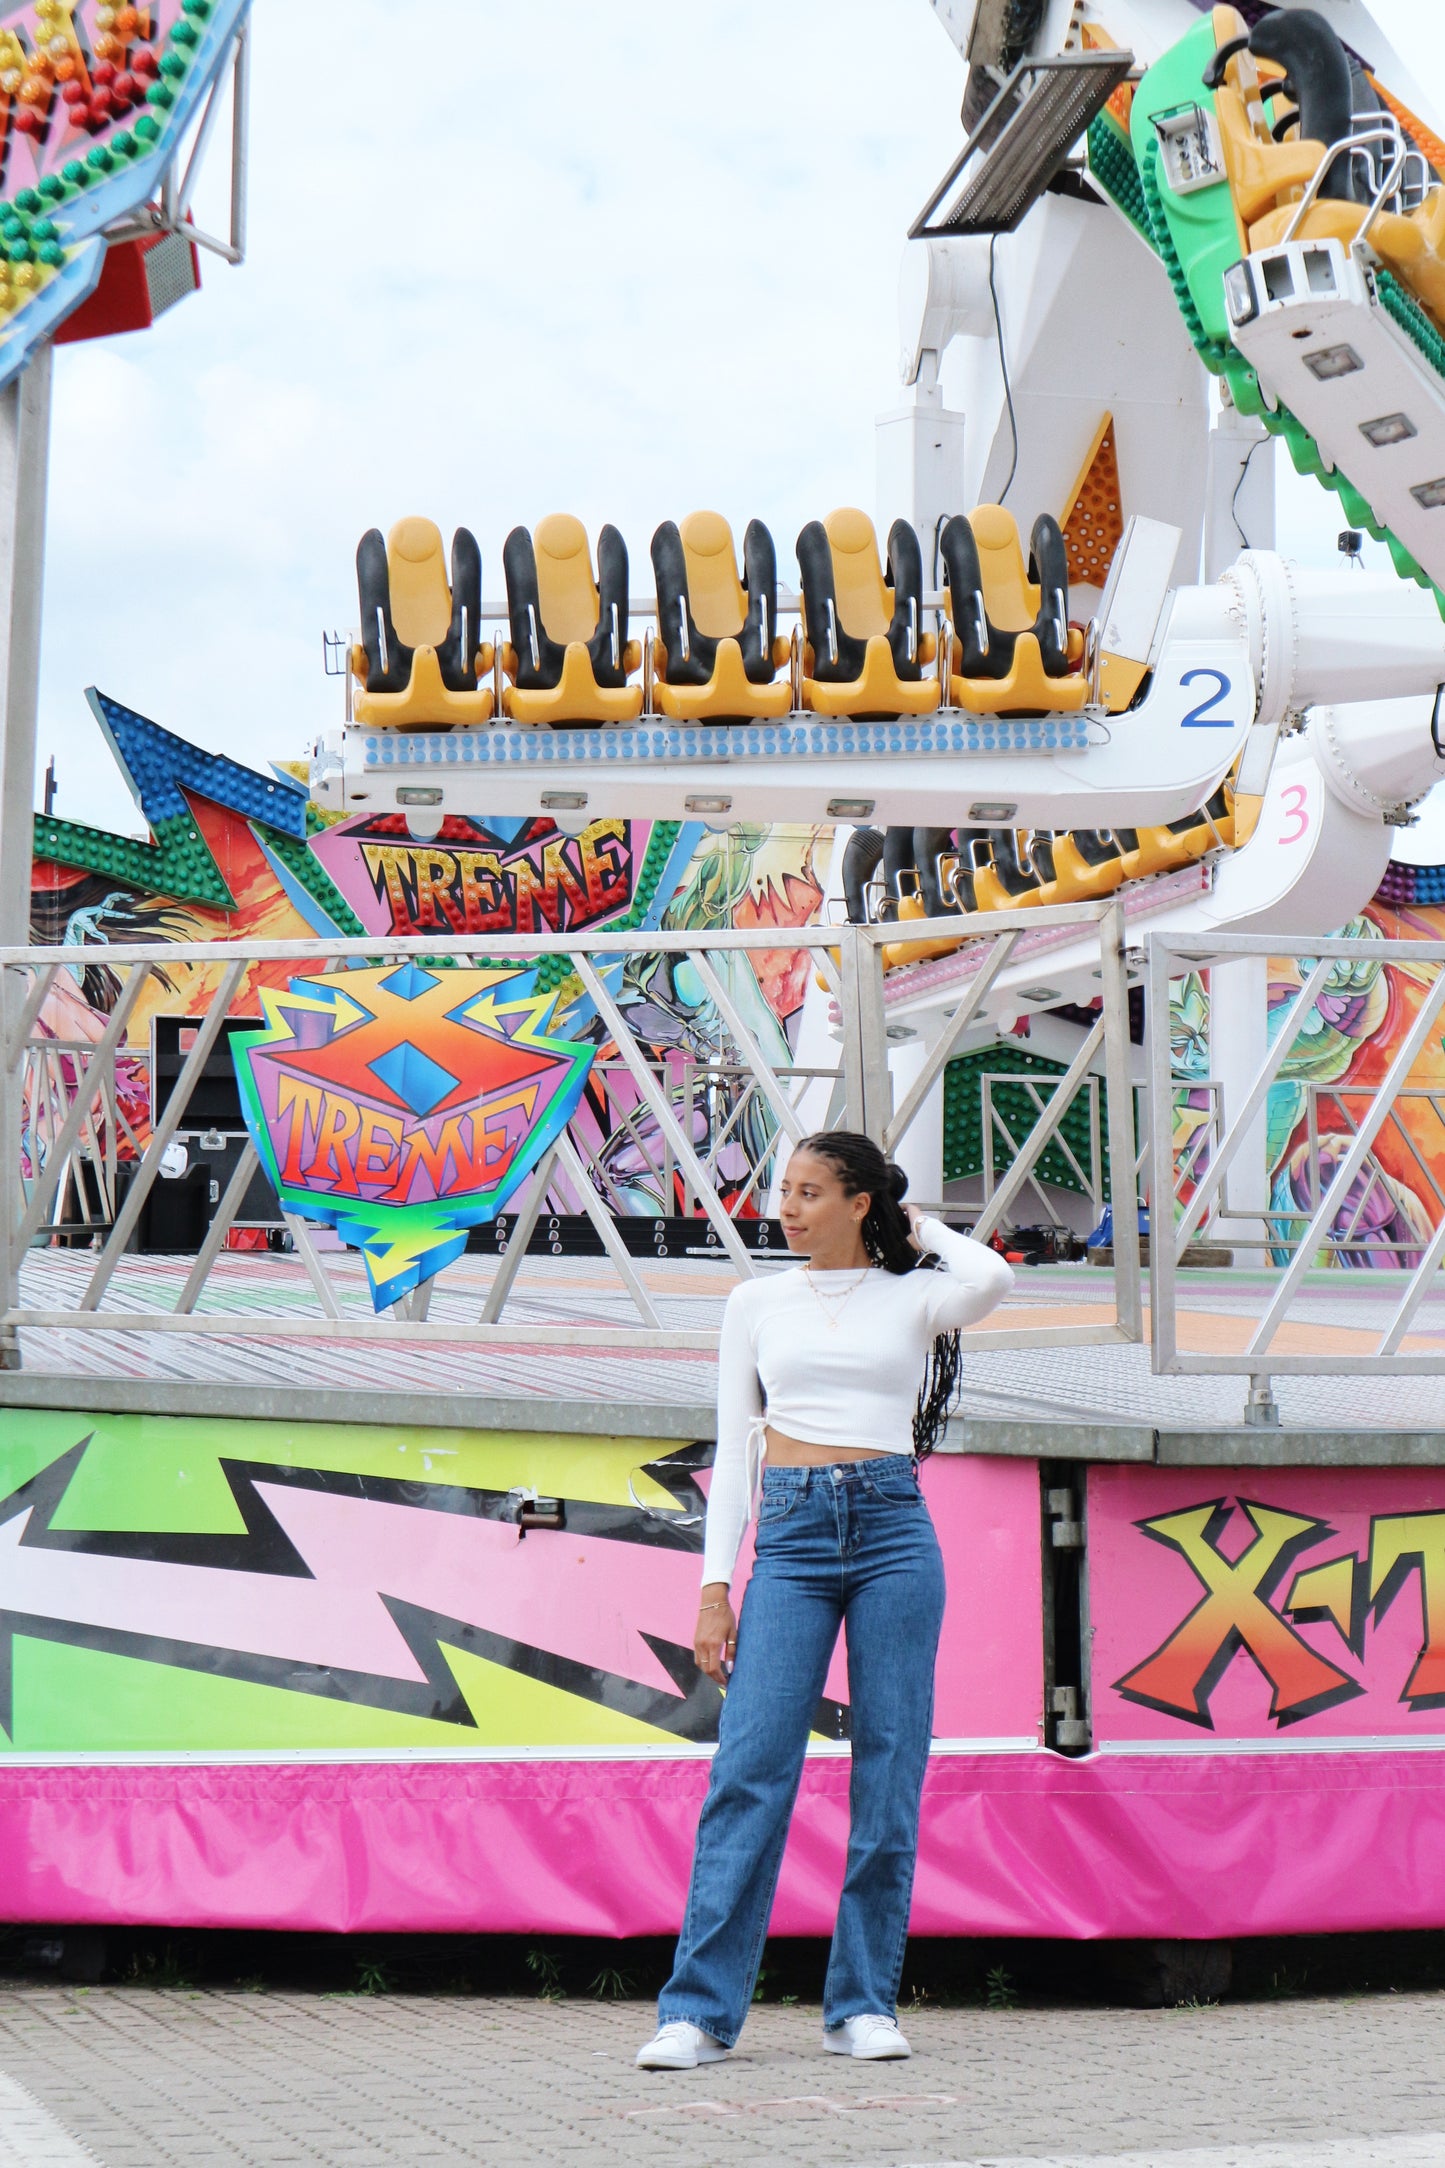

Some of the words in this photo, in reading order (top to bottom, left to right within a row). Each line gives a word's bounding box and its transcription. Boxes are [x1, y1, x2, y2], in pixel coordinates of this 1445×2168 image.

[1179, 669, 1235, 727] 2
[1278, 784, 1310, 845] 3
[358, 816, 632, 935] TREME
[257, 962, 569, 1121] X
[277, 1072, 541, 1203] TREME
